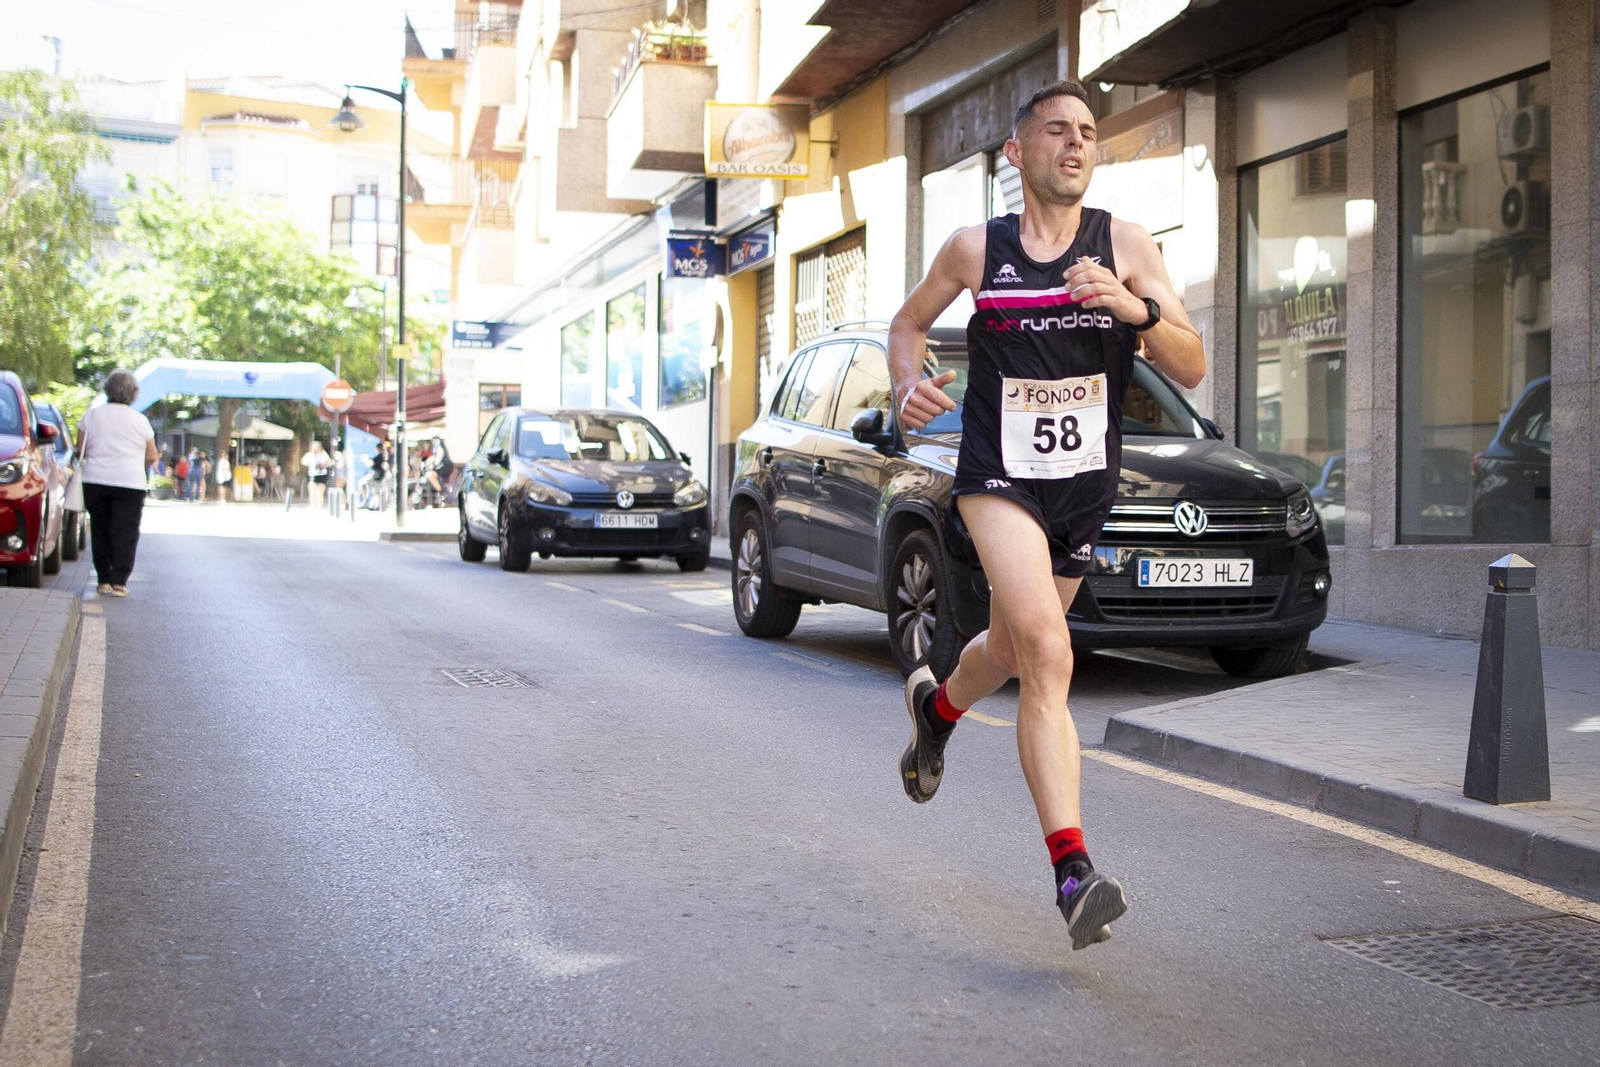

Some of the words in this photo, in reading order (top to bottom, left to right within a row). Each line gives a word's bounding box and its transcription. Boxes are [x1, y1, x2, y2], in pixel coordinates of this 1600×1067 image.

[717, 164, 748, 174] BAR
[753, 164, 802, 174] OASIS
[675, 258, 708, 271] MGS
[1027, 386, 1087, 405] FONDO
[1032, 415, 1083, 454] 58
[601, 515, 628, 527] 6611
[1155, 563, 1203, 583] 7023
[1214, 563, 1250, 583] HLZ
